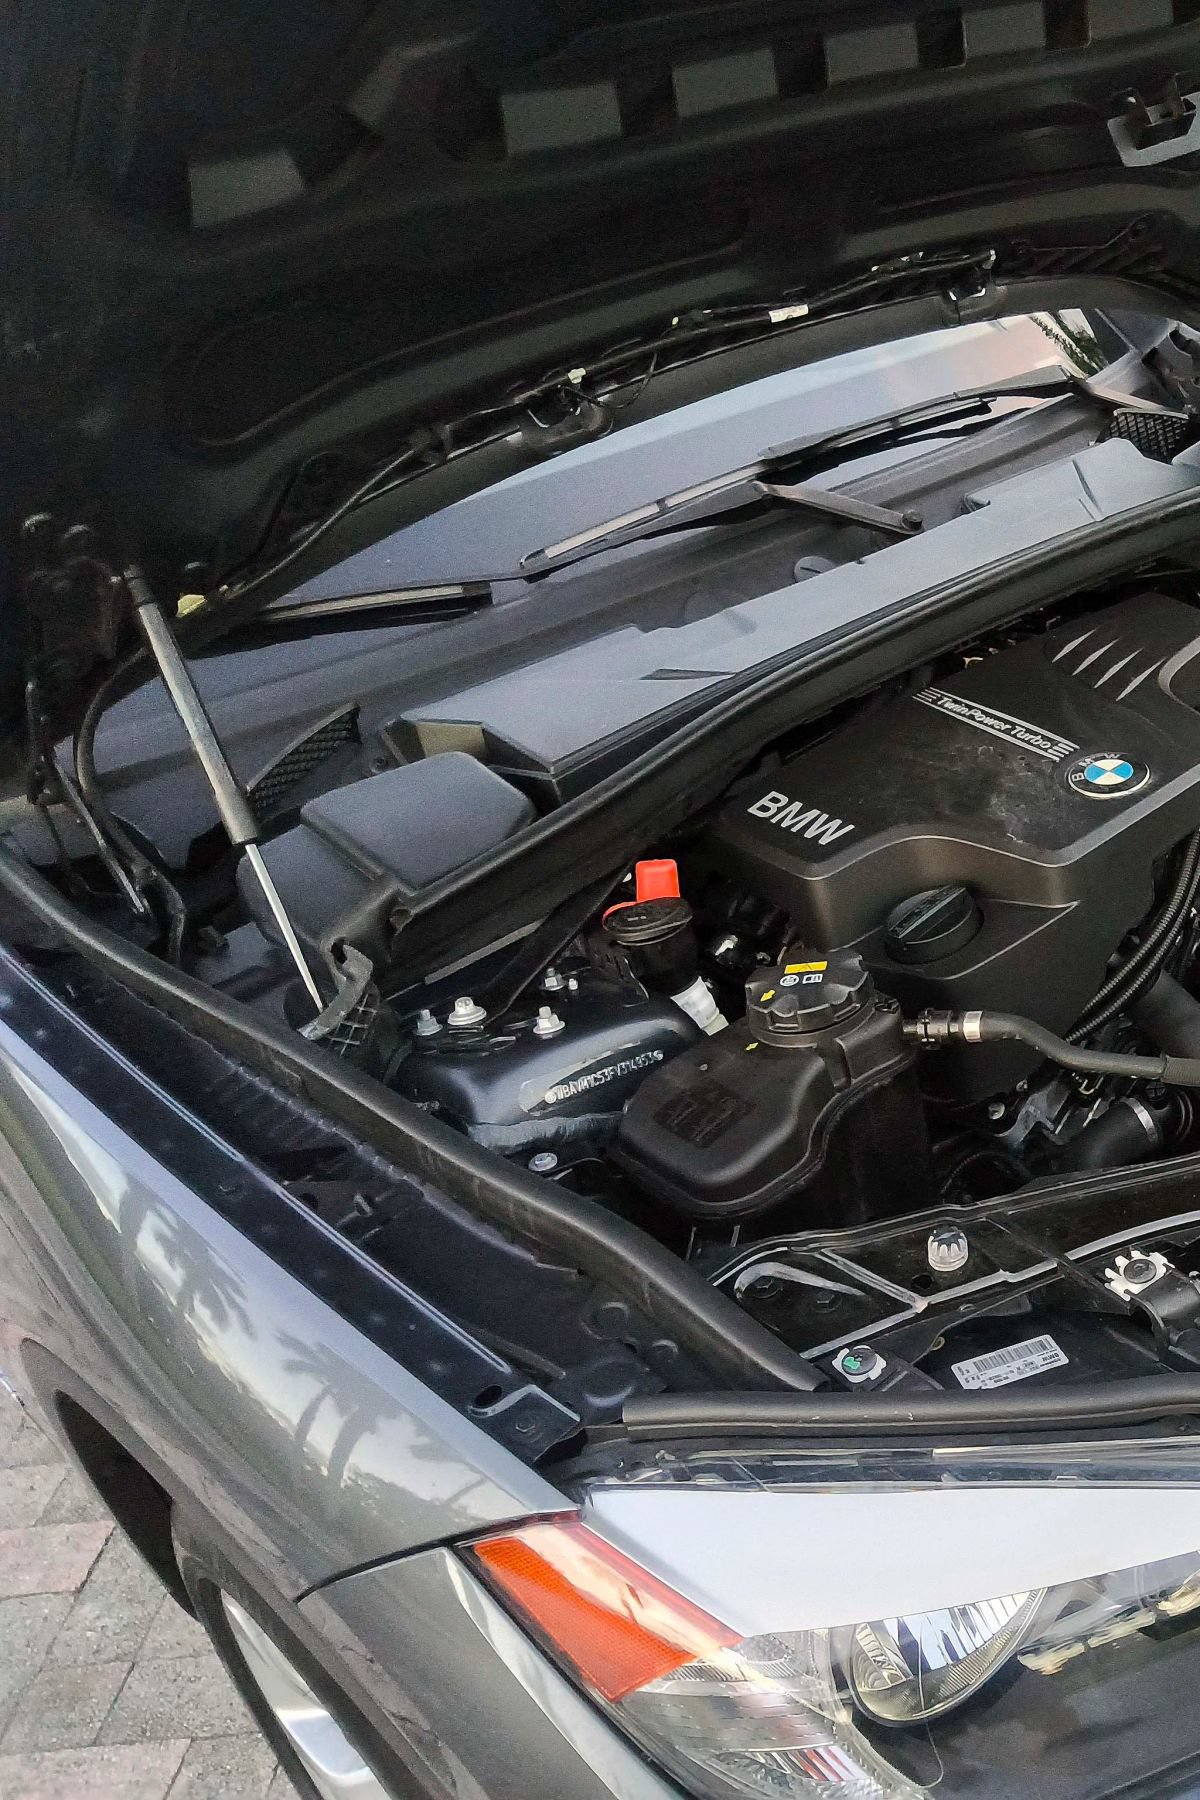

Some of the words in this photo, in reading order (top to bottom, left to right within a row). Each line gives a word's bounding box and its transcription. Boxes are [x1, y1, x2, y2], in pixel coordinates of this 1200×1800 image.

[936, 696, 1012, 731] TwinPower
[1010, 725, 1052, 749] Turbo
[1071, 752, 1121, 782] BMW
[747, 791, 855, 846] BMW
